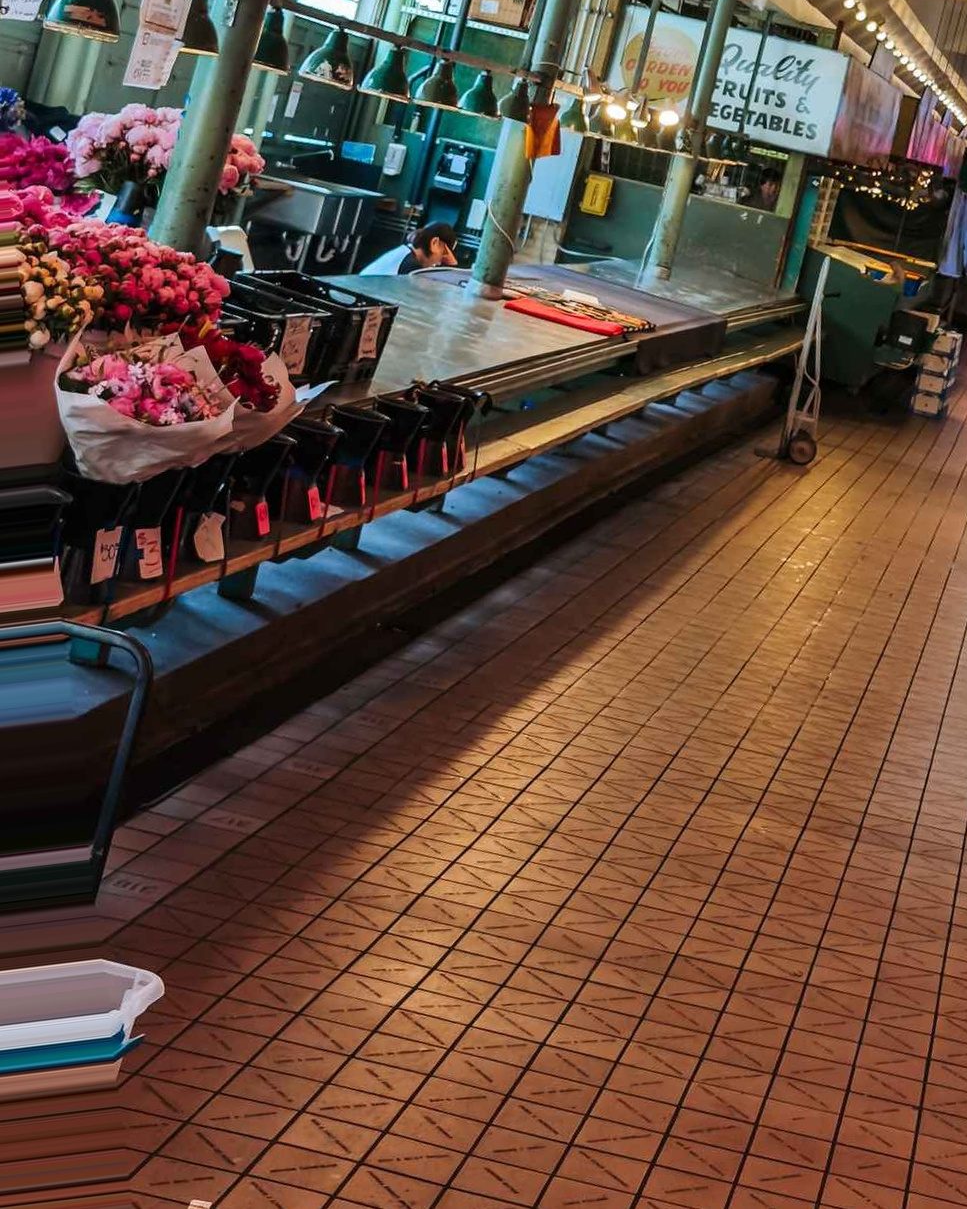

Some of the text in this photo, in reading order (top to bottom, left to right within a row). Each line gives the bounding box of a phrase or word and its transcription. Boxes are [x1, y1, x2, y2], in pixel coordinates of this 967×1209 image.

[717, 42, 822, 94] Quality
[713, 78, 787, 109] FRUITS
[708, 100, 818, 140] EGETABLES
